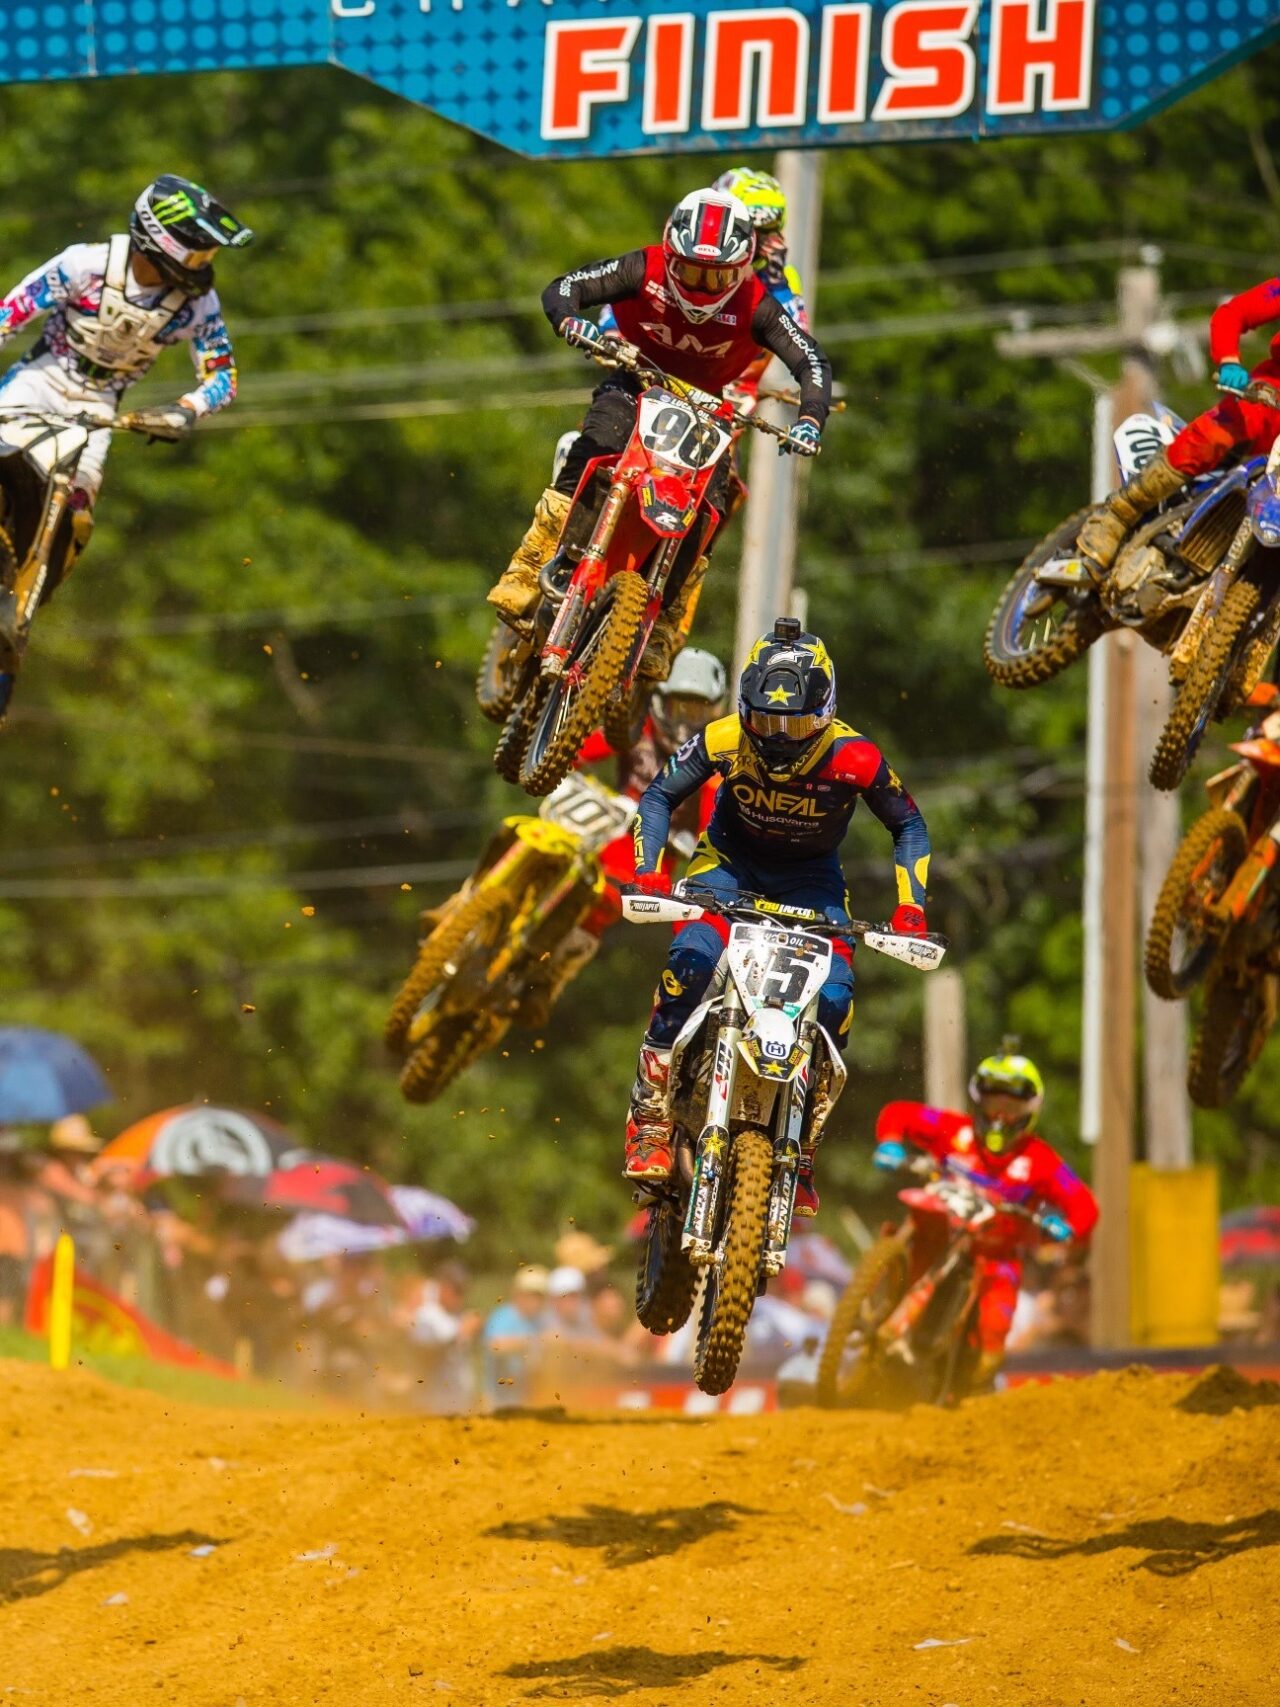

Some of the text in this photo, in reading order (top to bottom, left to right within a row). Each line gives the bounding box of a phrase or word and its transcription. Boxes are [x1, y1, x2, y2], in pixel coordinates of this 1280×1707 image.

[540, 0, 1096, 140] FINISH
[732, 784, 829, 817] ONEAL
[789, 936, 804, 947] OIL
